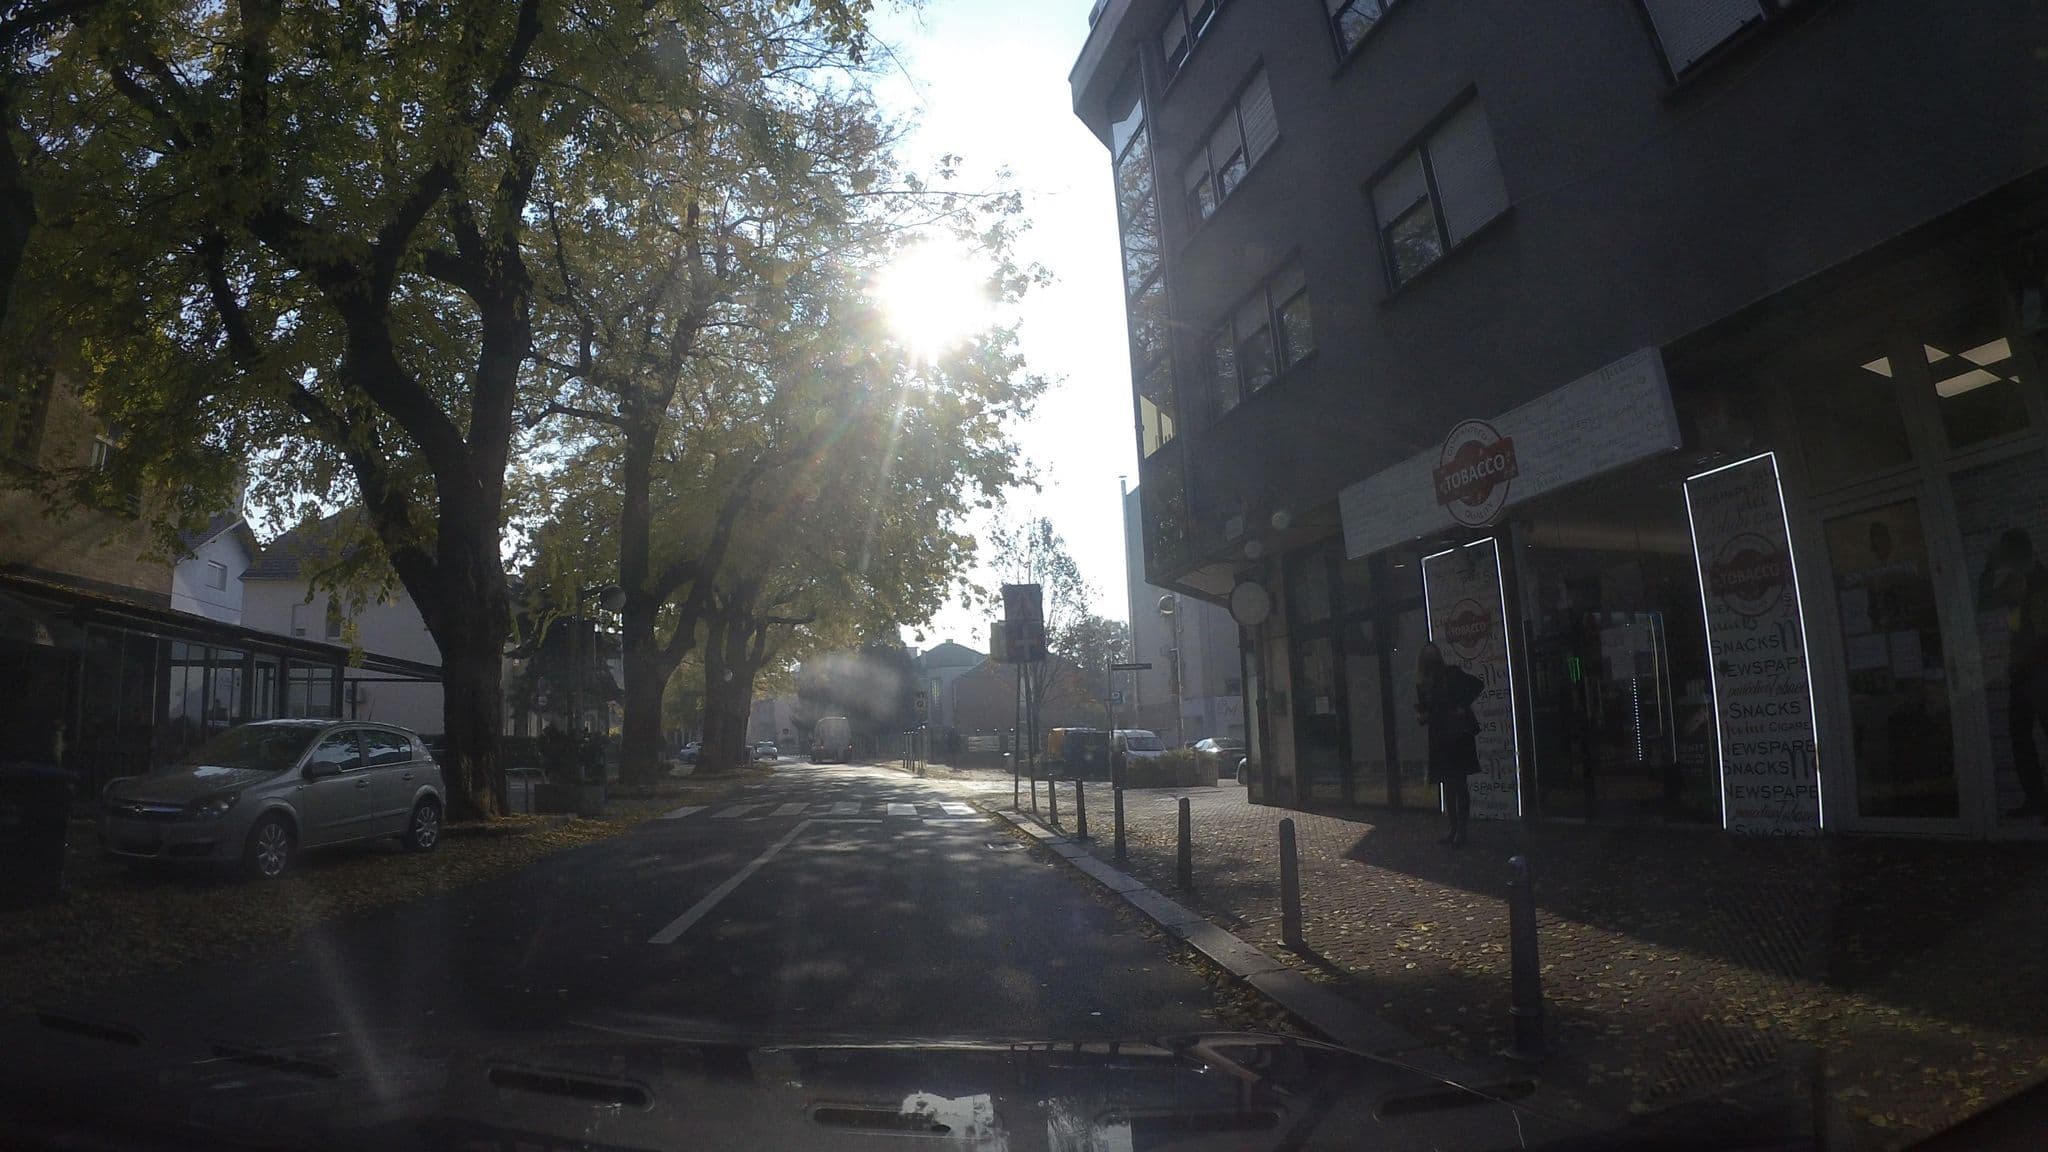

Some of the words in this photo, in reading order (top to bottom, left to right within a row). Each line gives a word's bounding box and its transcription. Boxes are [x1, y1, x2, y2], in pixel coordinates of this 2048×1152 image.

[1444, 454, 1505, 492] TOBACCO
[1711, 634, 1780, 655] SNACKS
[1729, 701, 1801, 719] SNACKS
[1723, 760, 1789, 775] SNACKS
